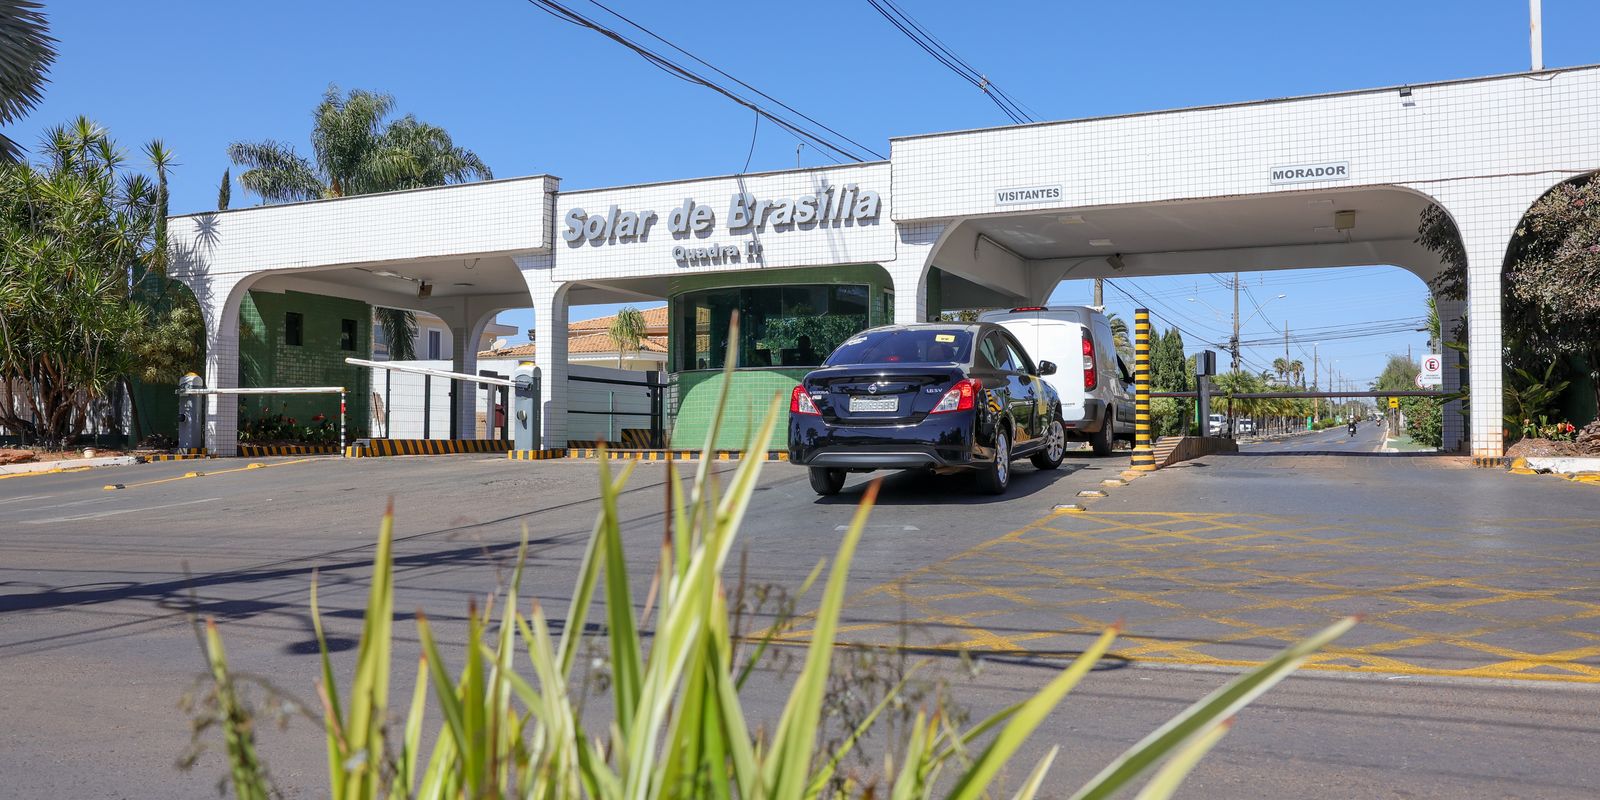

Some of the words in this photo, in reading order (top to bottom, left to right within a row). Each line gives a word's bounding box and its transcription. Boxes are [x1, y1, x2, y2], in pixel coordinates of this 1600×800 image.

[1273, 165, 1346, 180] MORADOR
[998, 188, 1060, 202] VISITANTES
[562, 204, 657, 245] Solar
[667, 197, 715, 239] de
[726, 184, 881, 233] Brasília
[672, 243, 740, 264] Quadra
